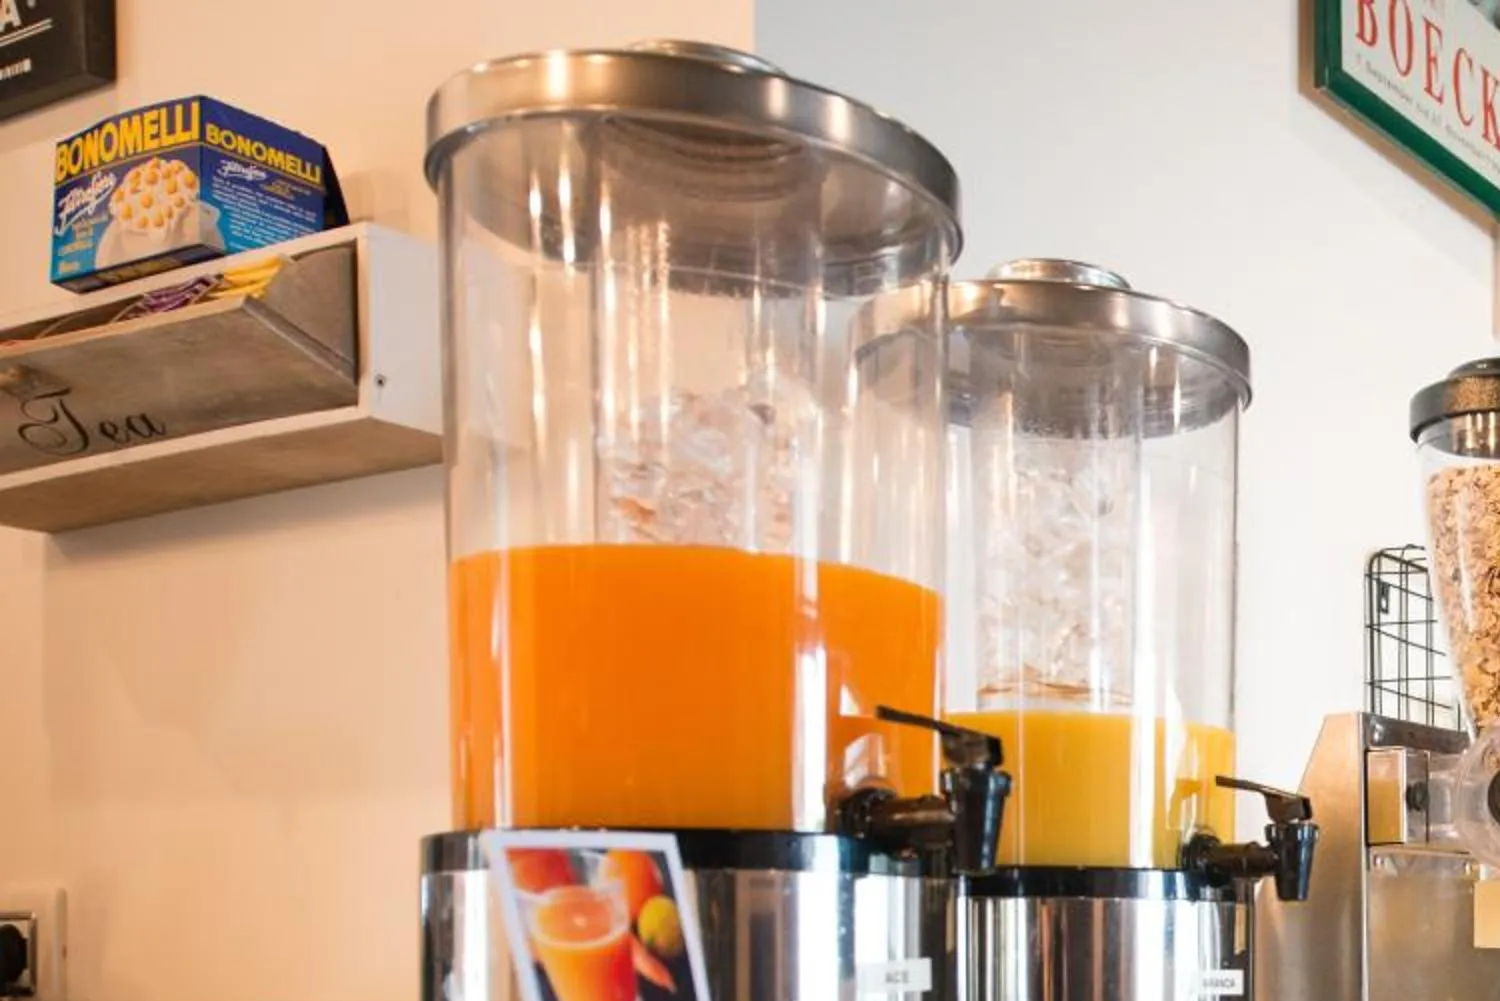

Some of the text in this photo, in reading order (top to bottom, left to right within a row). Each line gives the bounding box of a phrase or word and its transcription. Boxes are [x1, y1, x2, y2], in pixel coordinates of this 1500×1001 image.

[56, 101, 200, 183] BONOMELLI
[205, 122, 321, 184] BONOMELLI
[17, 387, 166, 457] Tea
